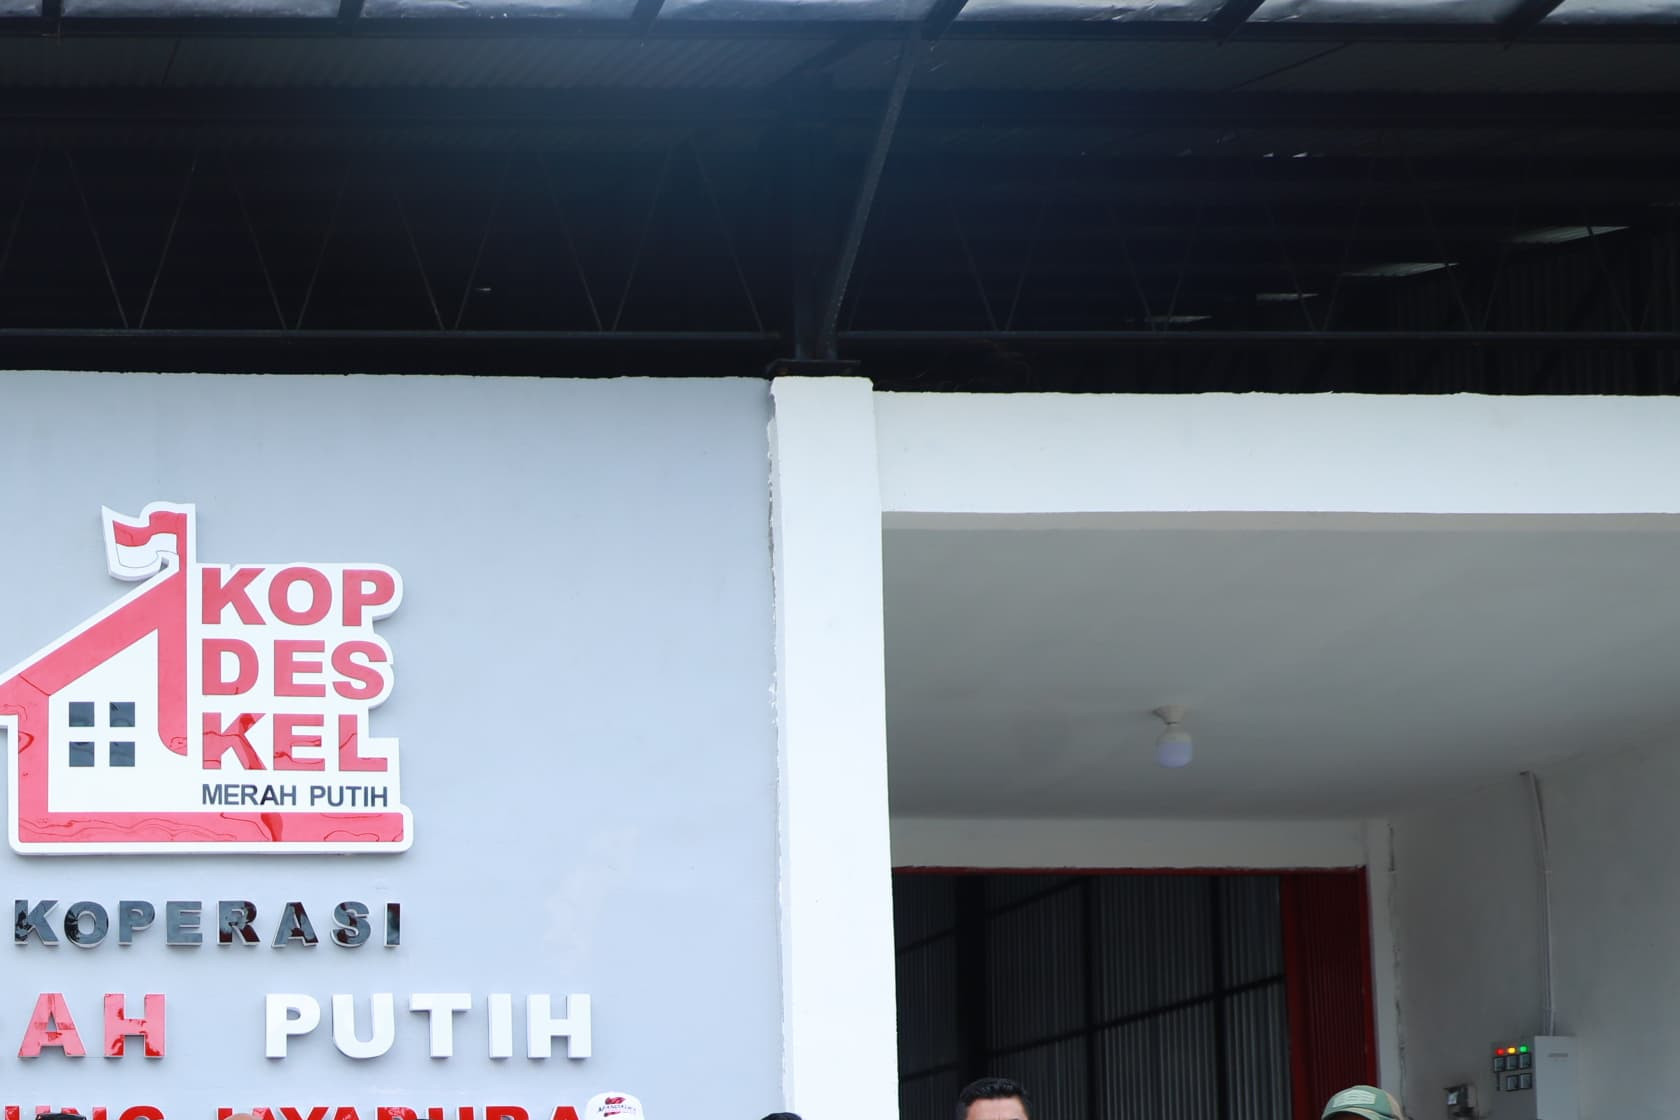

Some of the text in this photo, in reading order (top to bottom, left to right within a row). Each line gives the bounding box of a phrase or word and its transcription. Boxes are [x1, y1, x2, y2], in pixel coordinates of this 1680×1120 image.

[201, 566, 395, 627] KOP
[201, 638, 388, 701] DES
[201, 711, 389, 773] KEL
[201, 783, 388, 807] MERAH PUTIH
[13, 899, 402, 949] KOPERASI
[264, 992, 592, 1060] PUTIH
